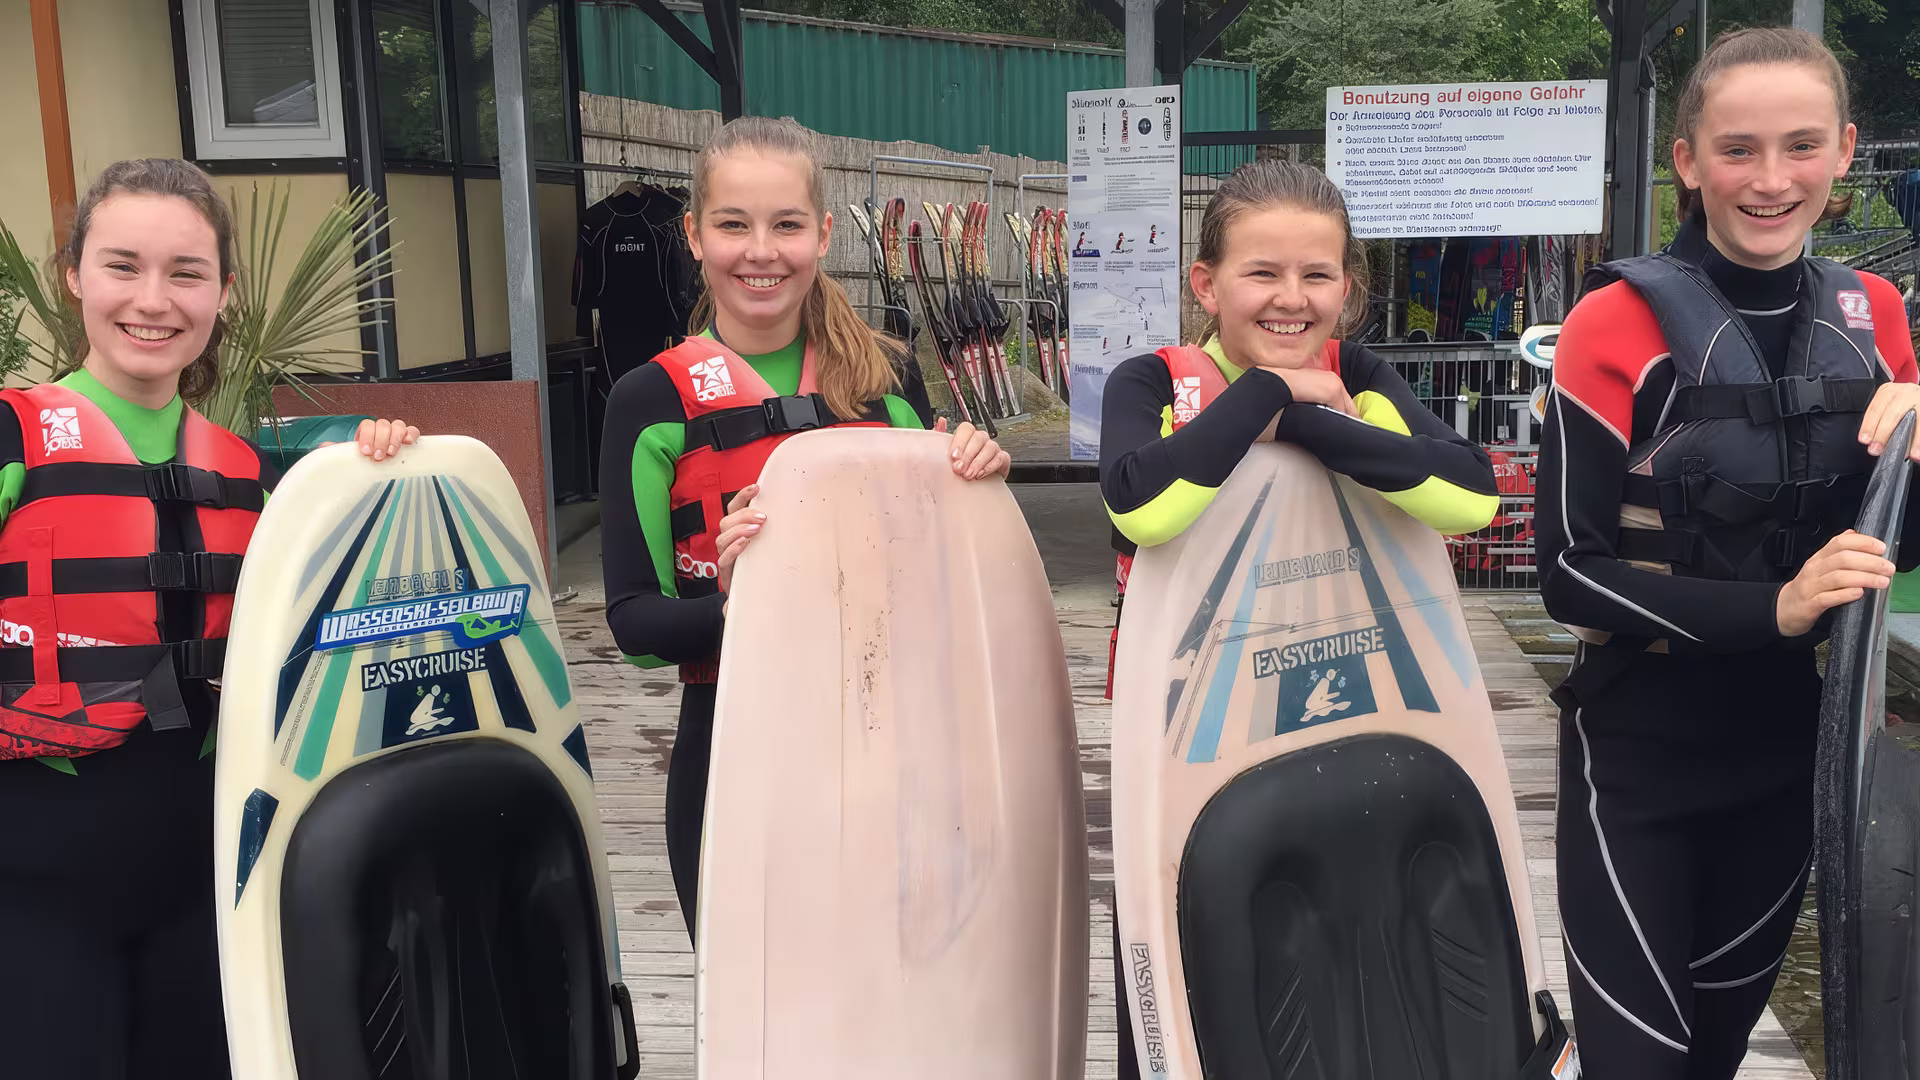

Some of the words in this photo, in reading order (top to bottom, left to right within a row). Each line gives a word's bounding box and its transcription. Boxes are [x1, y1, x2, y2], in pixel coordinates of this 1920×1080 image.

[1437, 88, 1462, 103] auf
[363, 648, 486, 690] EASYCRUISE
[1256, 627, 1385, 677] EASYCRUISE
